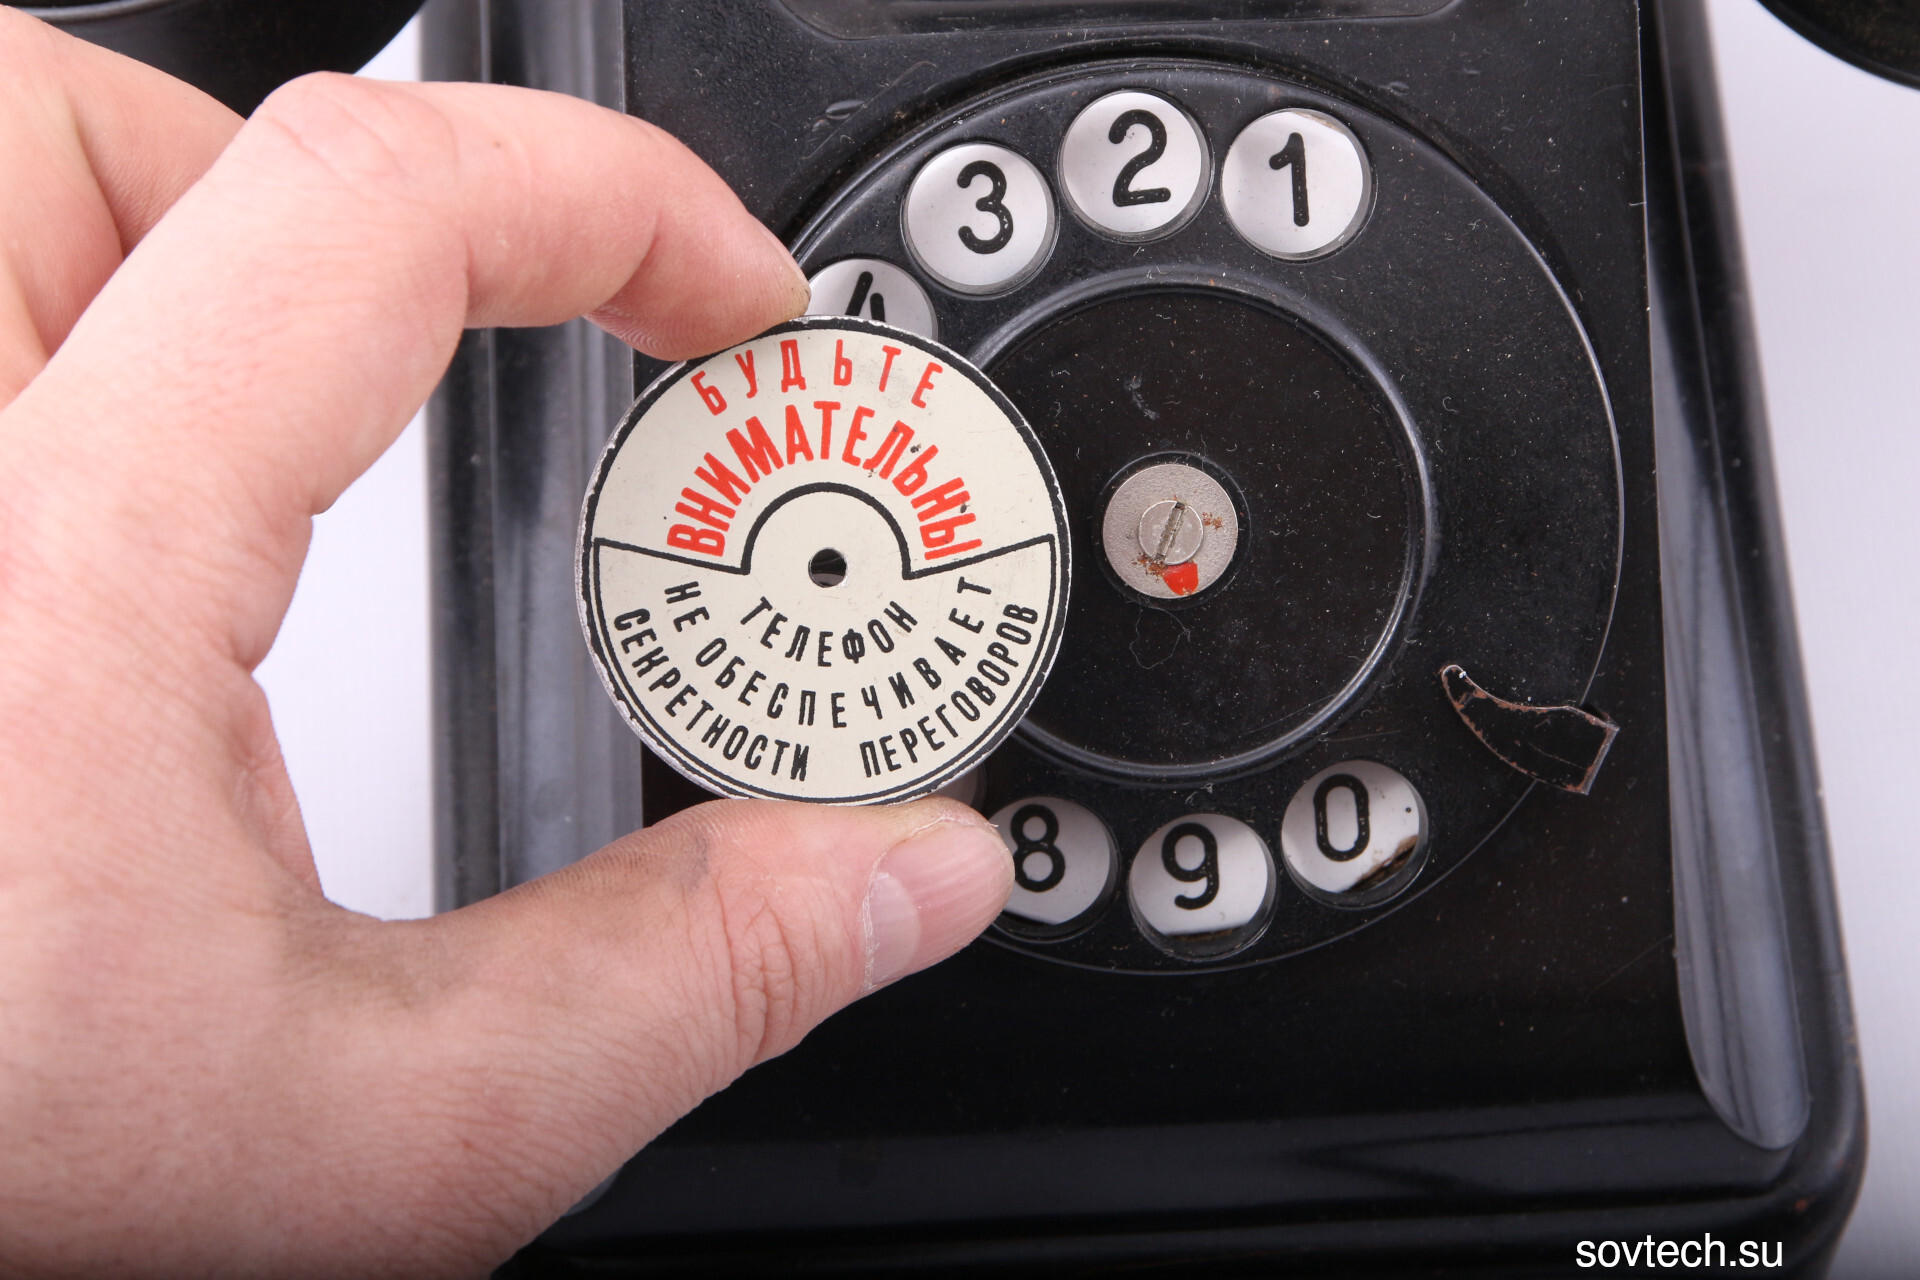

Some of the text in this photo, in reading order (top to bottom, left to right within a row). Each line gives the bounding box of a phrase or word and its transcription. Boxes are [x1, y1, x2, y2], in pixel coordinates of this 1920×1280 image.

[1108, 108, 1171, 208] 2
[1268, 132, 1310, 227] 1
[957, 160, 1014, 254] 3
[690, 339, 943, 416] БУДЬТЕ
[666, 400, 983, 560] ВНИМАТЕЛЬНЫ
[664, 576, 992, 729] НЕ ОБЕСПЕЧИВАЕТ
[740, 596, 918, 667] ТЕЛЕФОН
[613, 604, 1039, 781] СЕКРЕТНОСТИ ПЕРЕГОВОРОВ
[1010, 804, 1065, 893] 8
[1313, 774, 1370, 861] 0
[1162, 822, 1219, 909] 9
